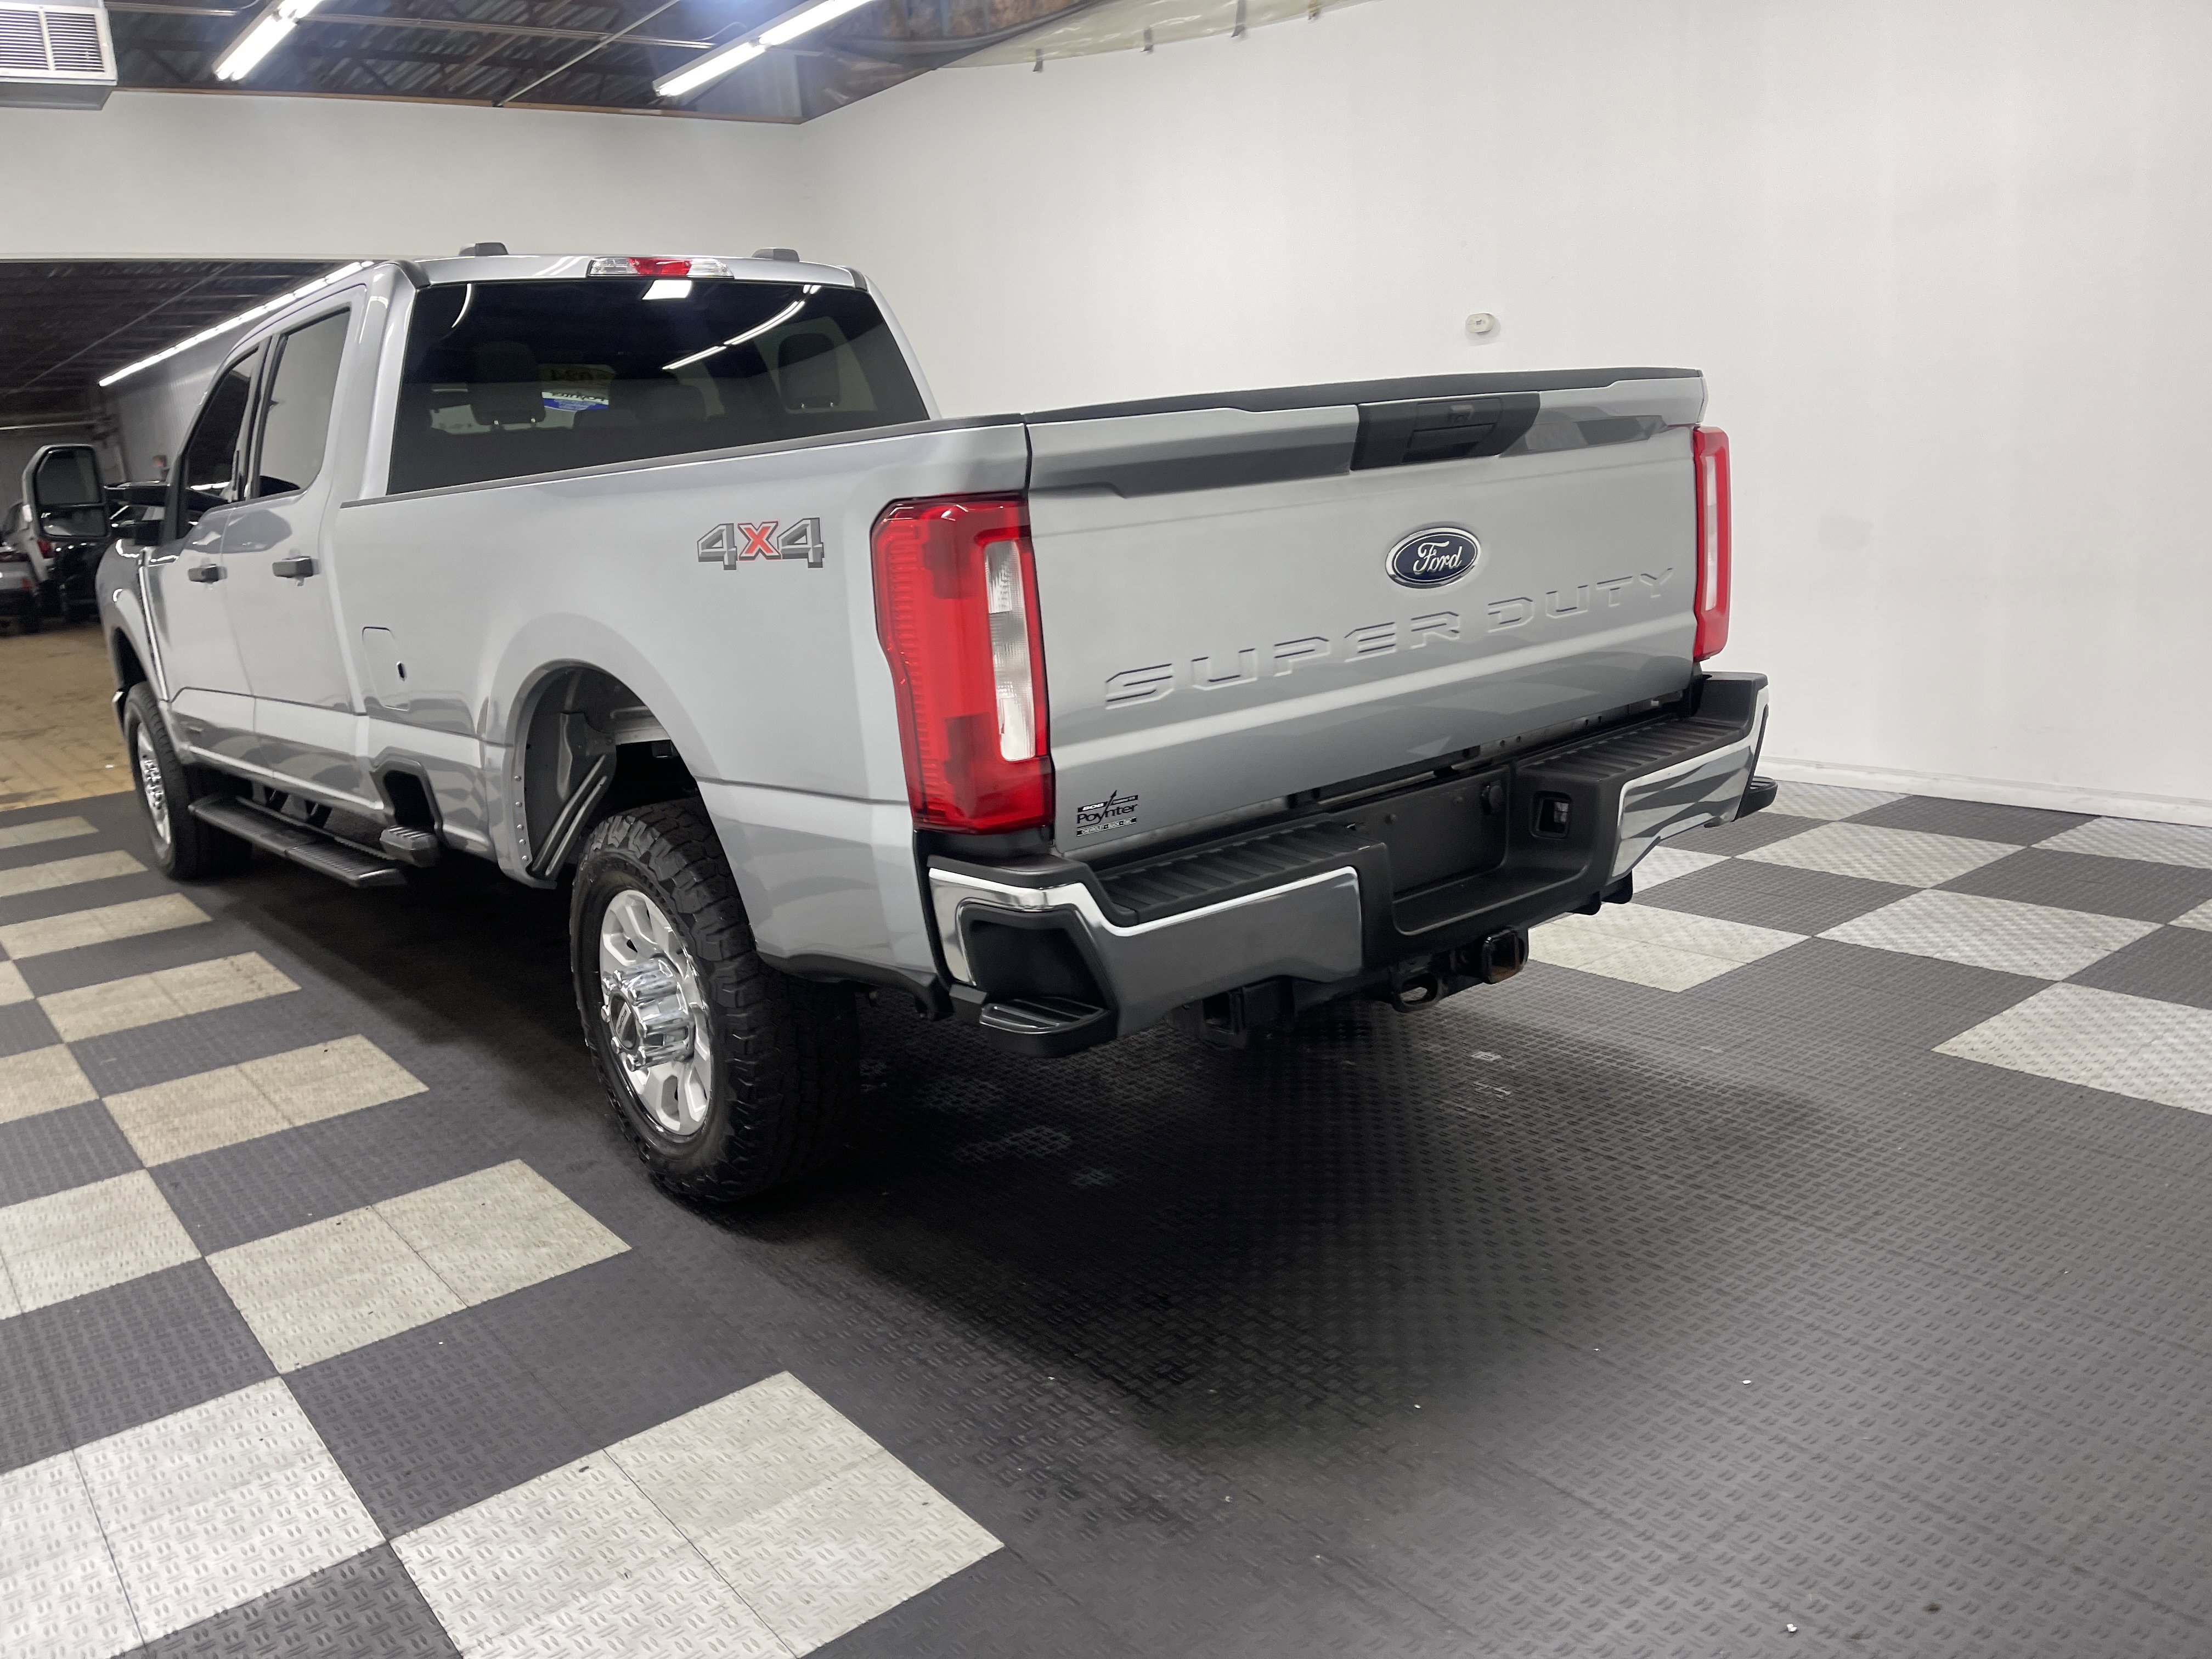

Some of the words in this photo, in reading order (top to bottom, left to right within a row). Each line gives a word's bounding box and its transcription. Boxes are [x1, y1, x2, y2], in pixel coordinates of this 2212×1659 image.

[1413, 540, 1463, 575] Ford
[1105, 610, 1462, 710] SUPER
[1486, 567, 1675, 634] DUTY
[1076, 803, 1137, 827] Poynter
